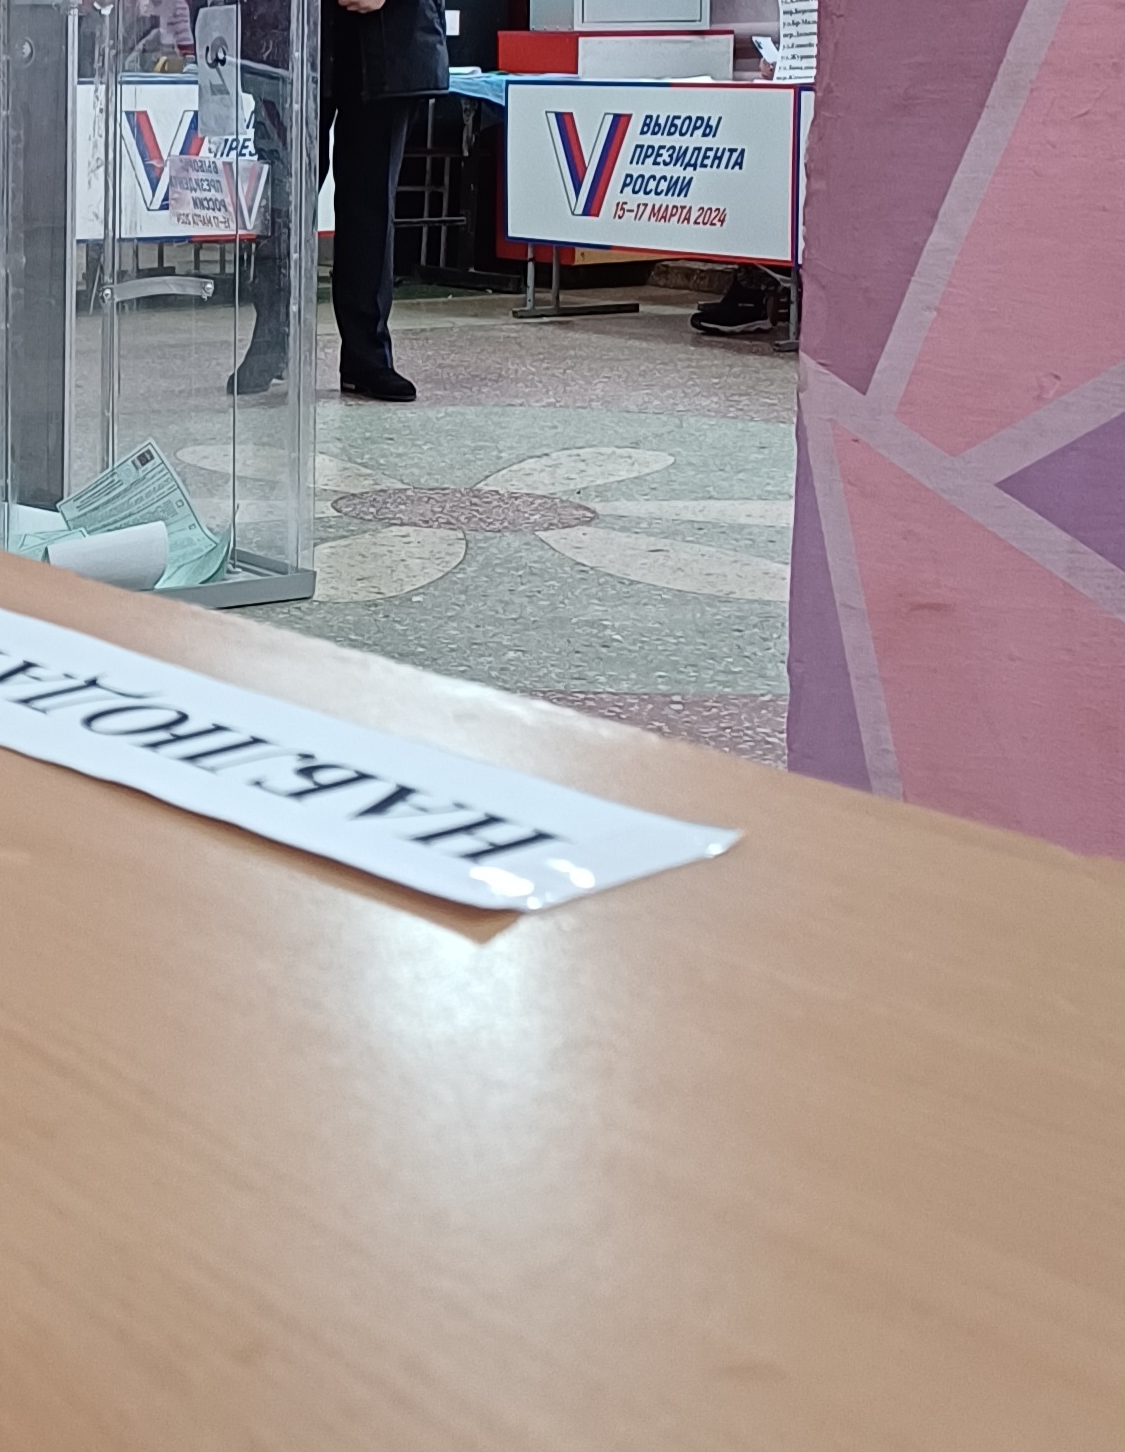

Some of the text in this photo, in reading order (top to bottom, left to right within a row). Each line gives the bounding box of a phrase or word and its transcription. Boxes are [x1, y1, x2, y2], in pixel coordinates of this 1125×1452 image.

[639, 114, 723, 138] ВЫБОРЫ
[629, 144, 746, 171] ПРЕЗИДЕНТА
[620, 173, 693, 198] РОССИИ
[649, 204, 692, 225] МАРТА
[693, 206, 727, 227] 2024
